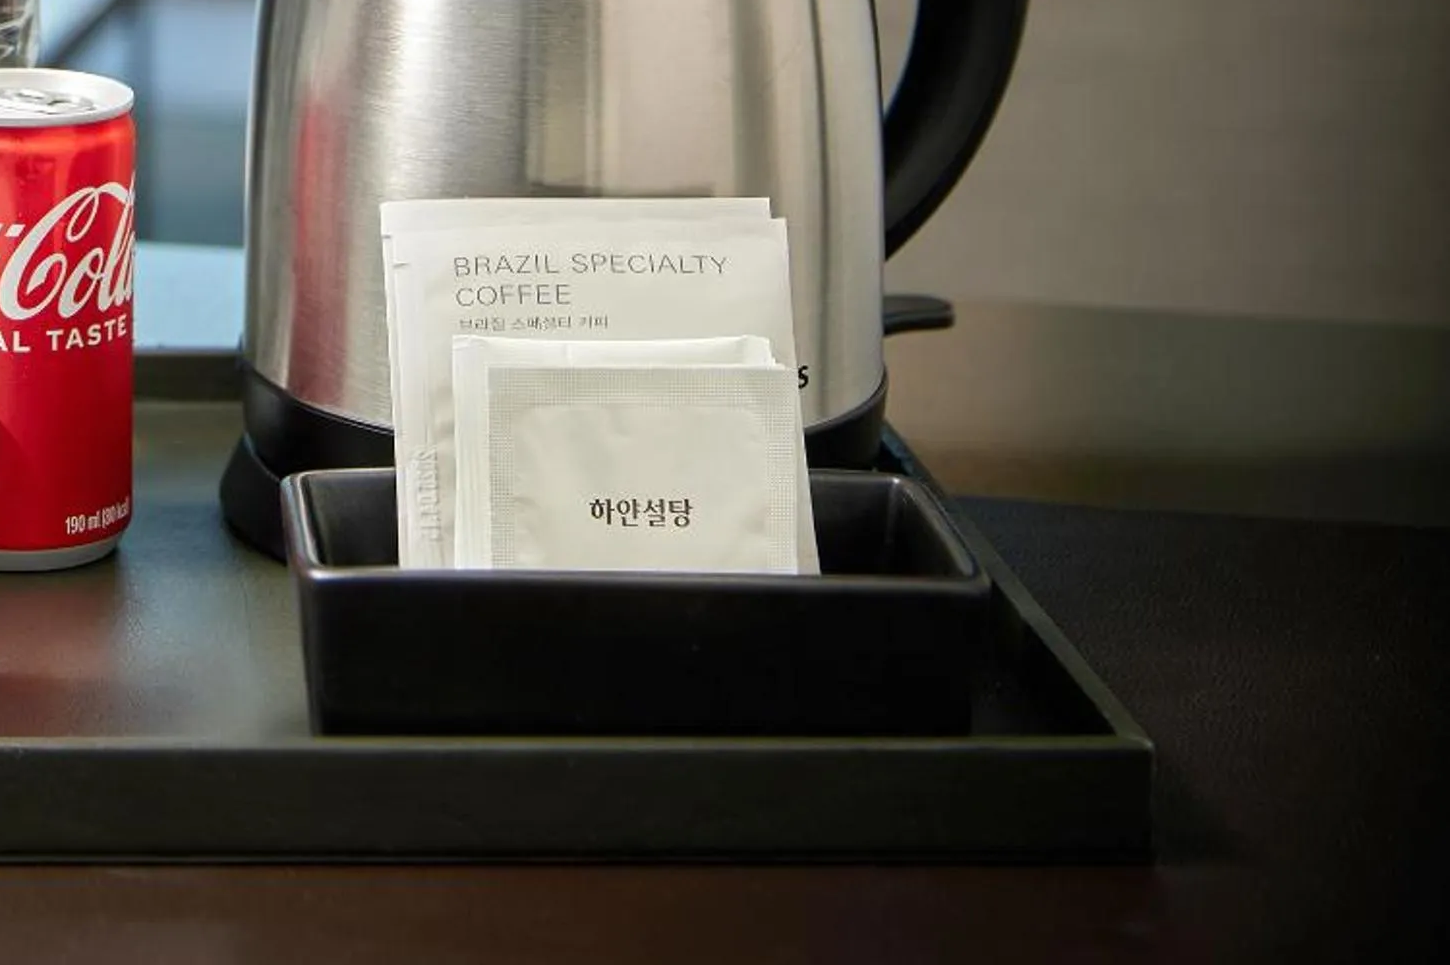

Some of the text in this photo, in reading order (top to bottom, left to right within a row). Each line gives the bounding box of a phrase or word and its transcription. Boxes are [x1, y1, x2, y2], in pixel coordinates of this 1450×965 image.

[453, 253, 728, 277] BRAZIL SPECIALTY
[455, 284, 572, 306] COFFEE
[46, 315, 127, 351] TASTE
[459, 315, 506, 331] 브라질
[588, 498, 693, 527] 하얀설탕
[65, 514, 86, 535] 190
